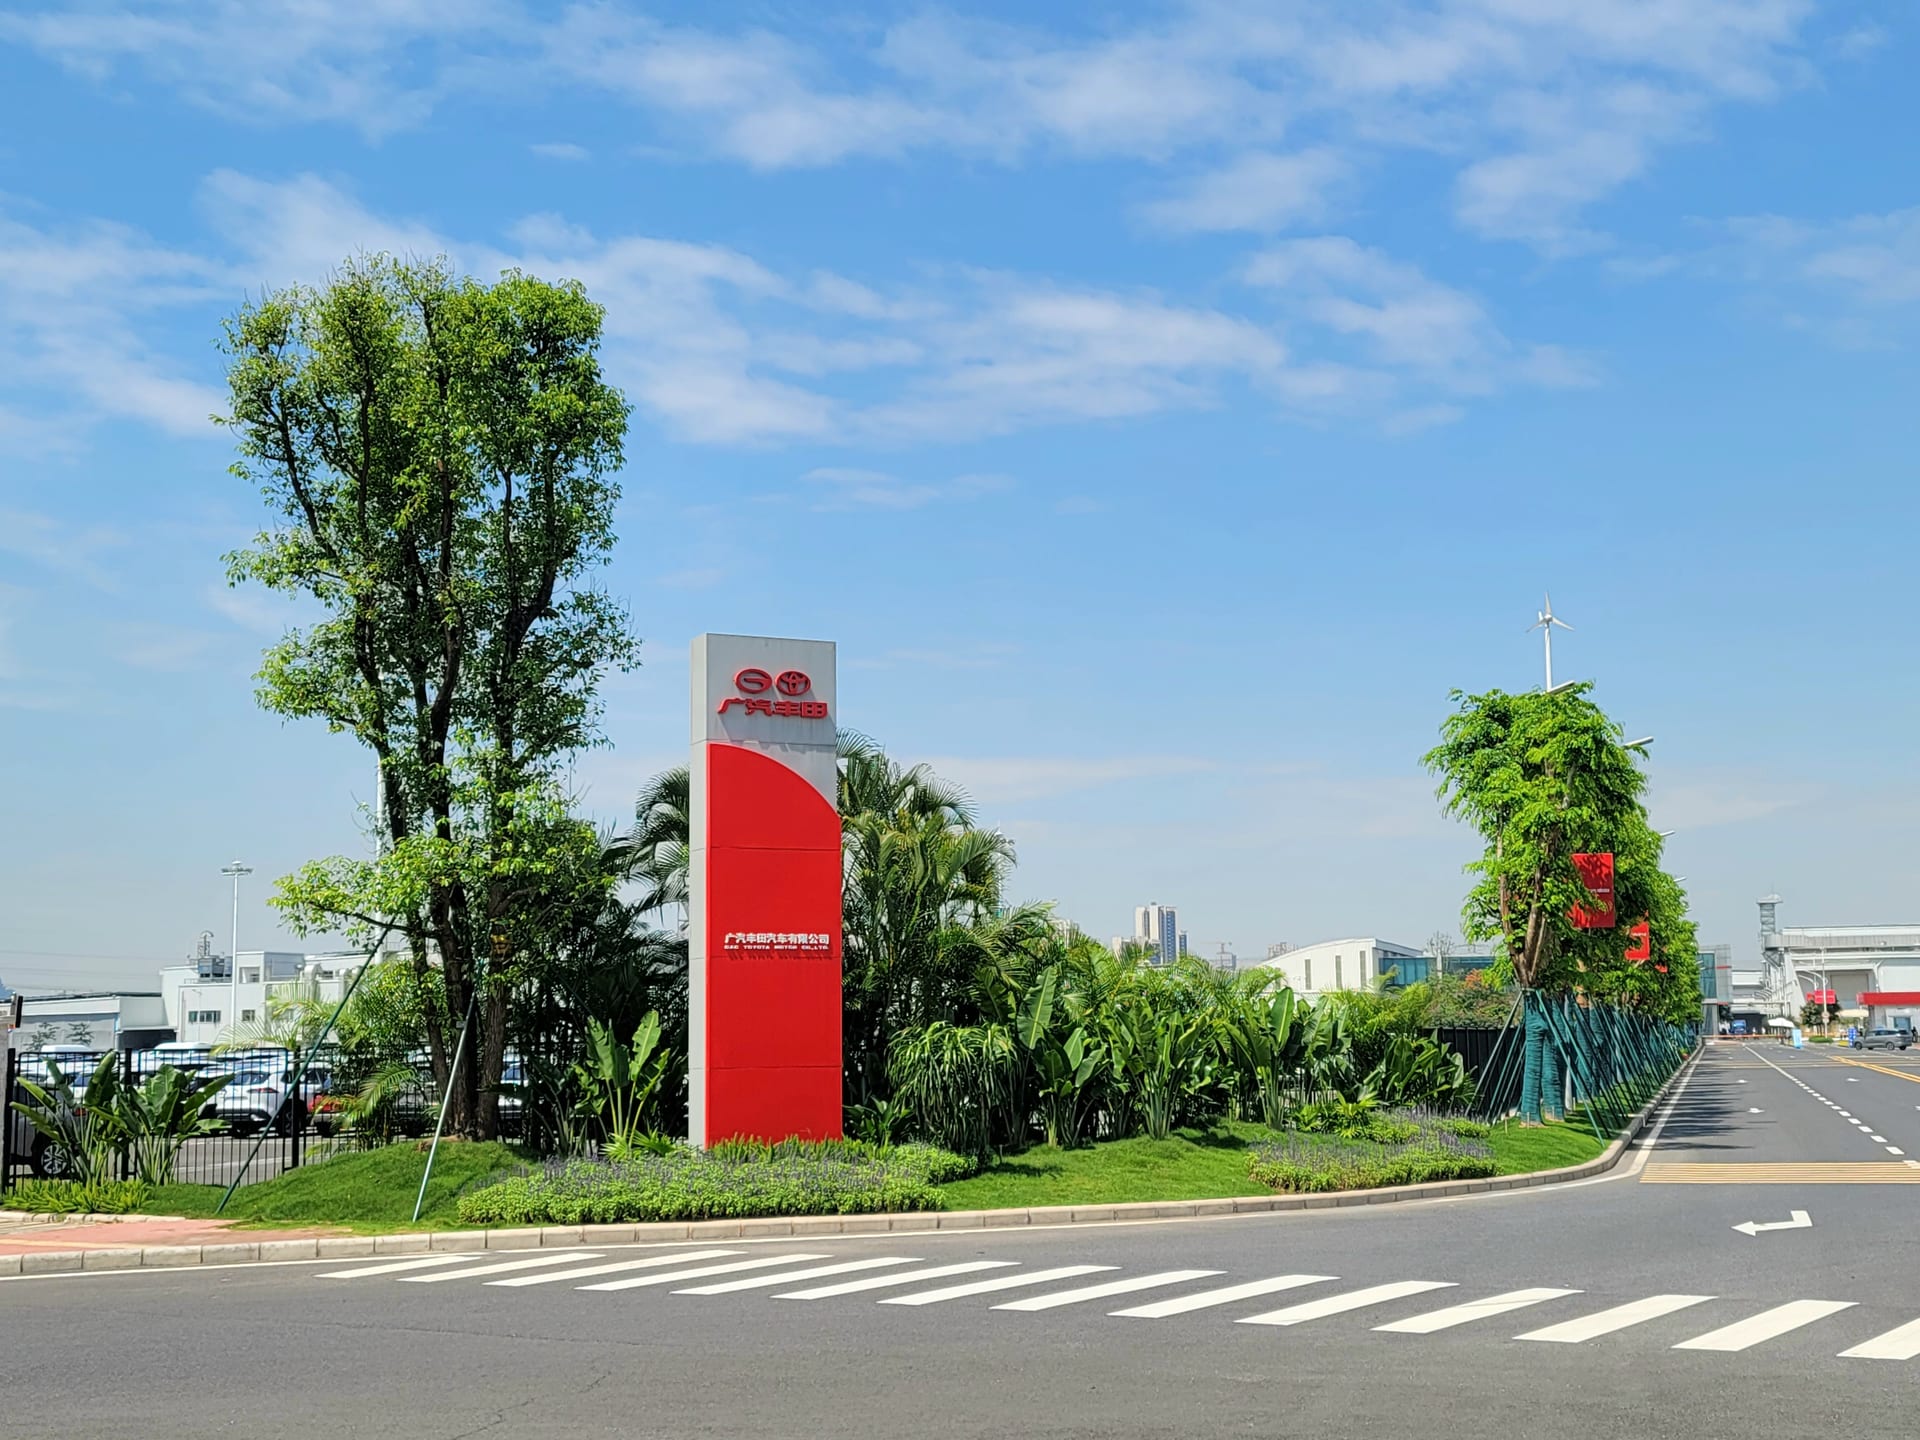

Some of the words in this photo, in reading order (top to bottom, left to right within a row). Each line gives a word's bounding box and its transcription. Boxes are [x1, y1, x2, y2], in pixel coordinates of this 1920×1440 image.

[718, 698, 828, 719] 广汽丰田
[725, 932, 830, 944] 广汽丰田汽车有限公司
